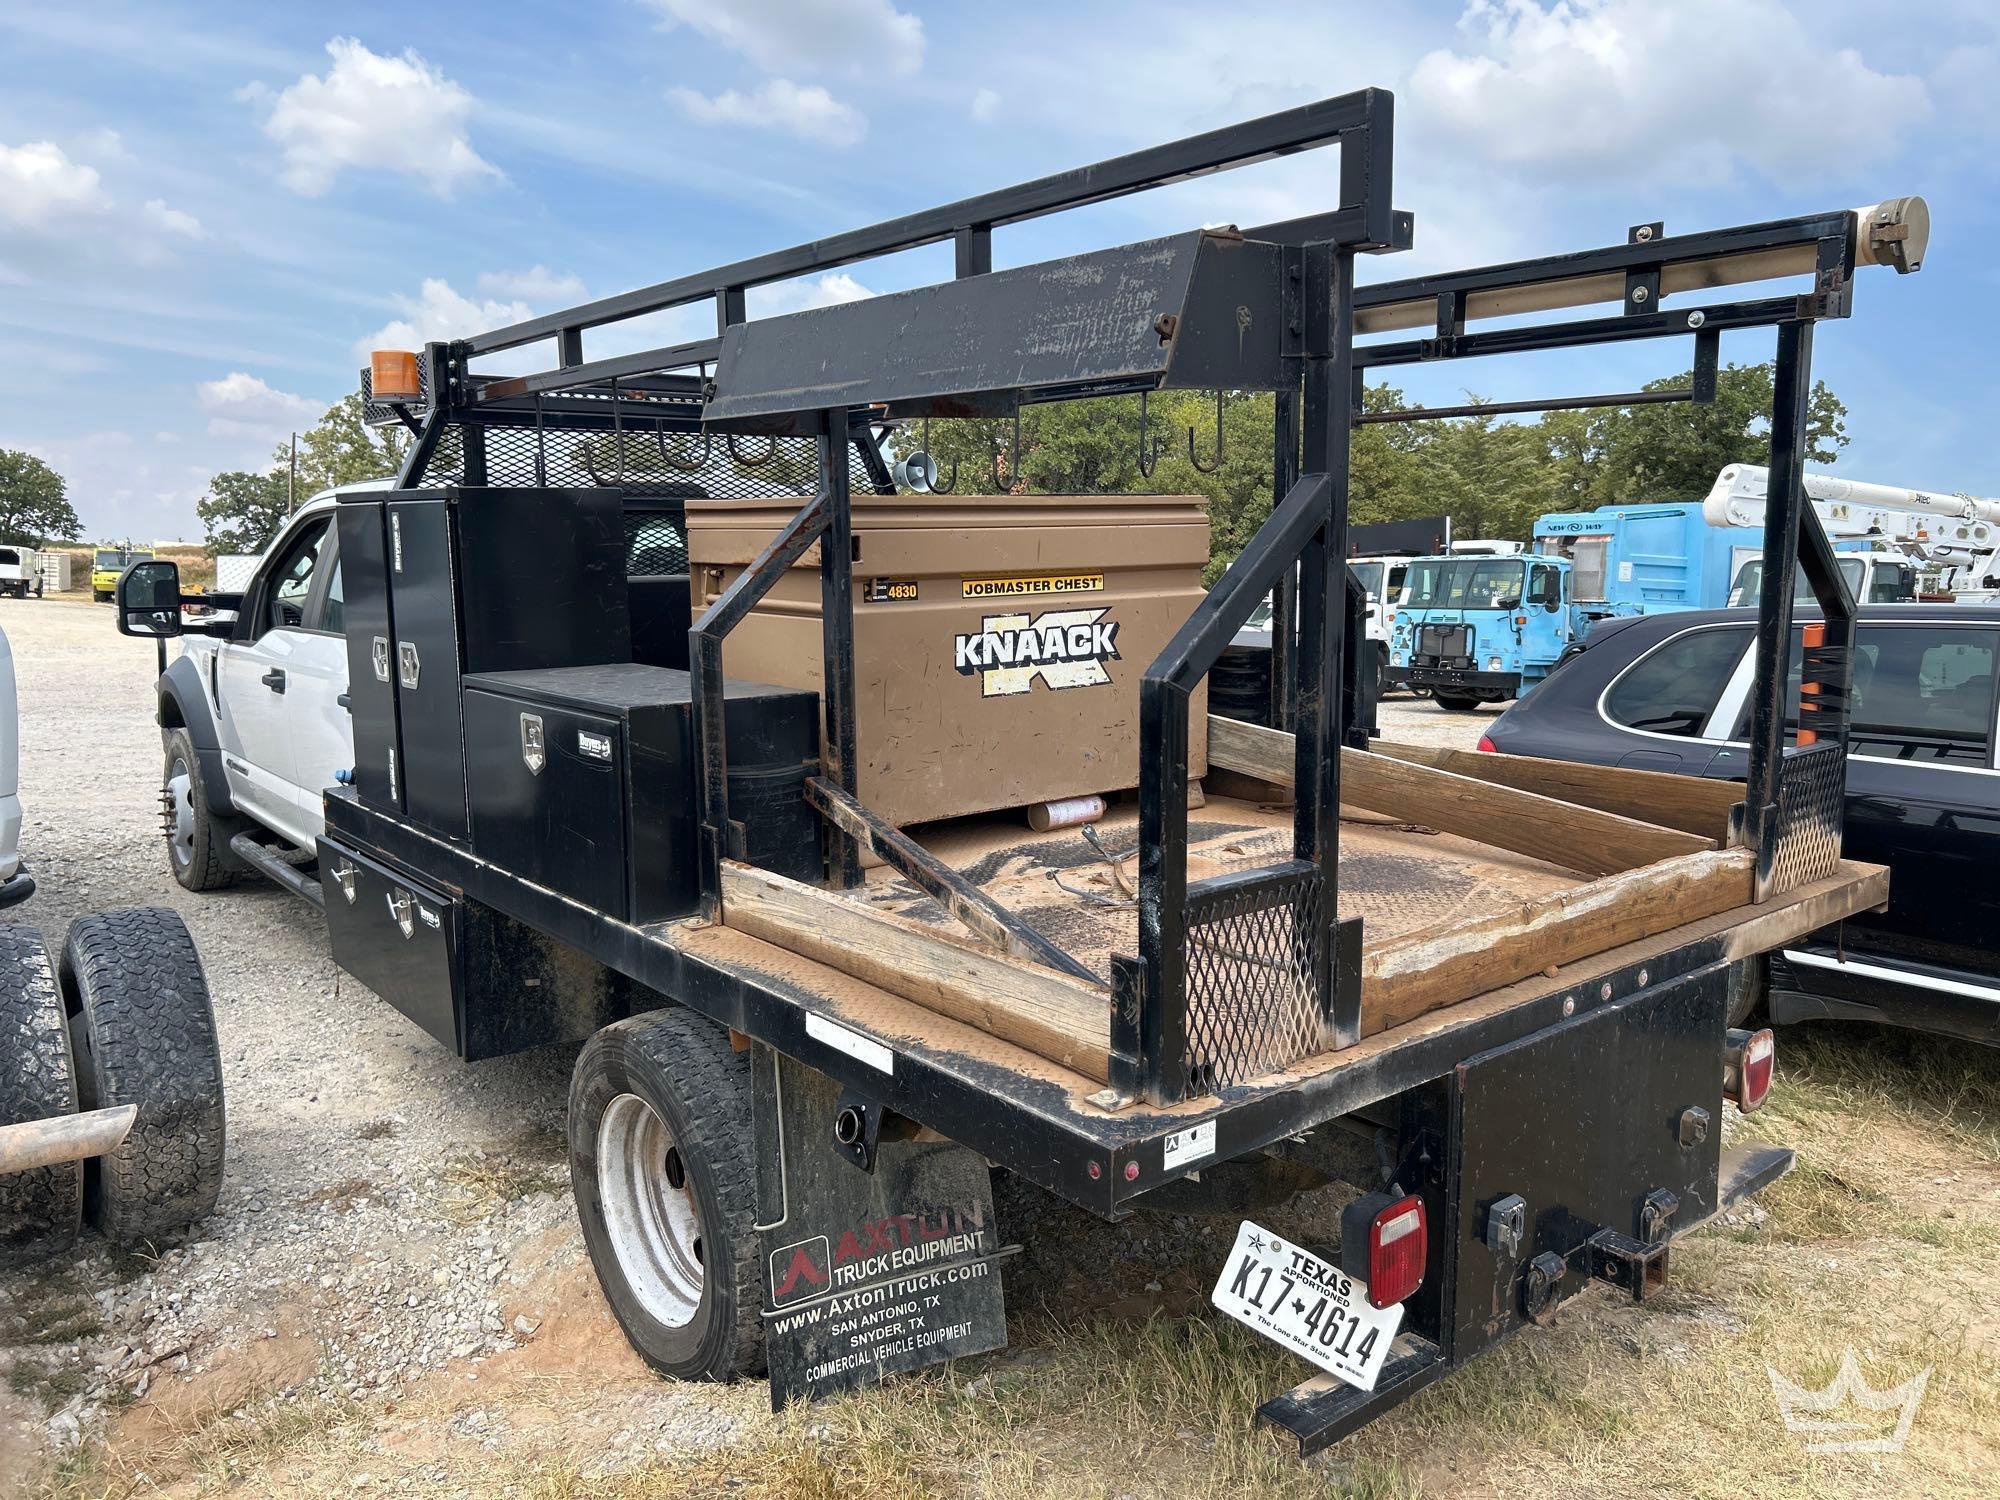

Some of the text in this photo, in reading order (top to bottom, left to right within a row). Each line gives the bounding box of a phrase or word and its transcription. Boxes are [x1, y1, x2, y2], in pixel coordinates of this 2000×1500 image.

[1547, 523, 1604, 532] NEW WAY
[888, 585, 917, 598] 4830
[964, 577, 1099, 596] JOBMASTER CHEST
[955, 622, 1119, 672] KNAACK
[834, 1231, 985, 1286] TRUCK EQUIPMENT
[1289, 1250, 1353, 1297] TEXAS
[1282, 1266, 1351, 1308] APPORTIONED
[831, 1294, 941, 1336] SAN ANTONIO, TX
[850, 1315, 926, 1348] SNYDER, TX
[1230, 1254, 1381, 1368] K17 4614
[806, 1321, 973, 1383] COMMERCIAL VEHICLE EQUIPMENT
[1257, 1314, 1331, 1361] The Lone Star State
